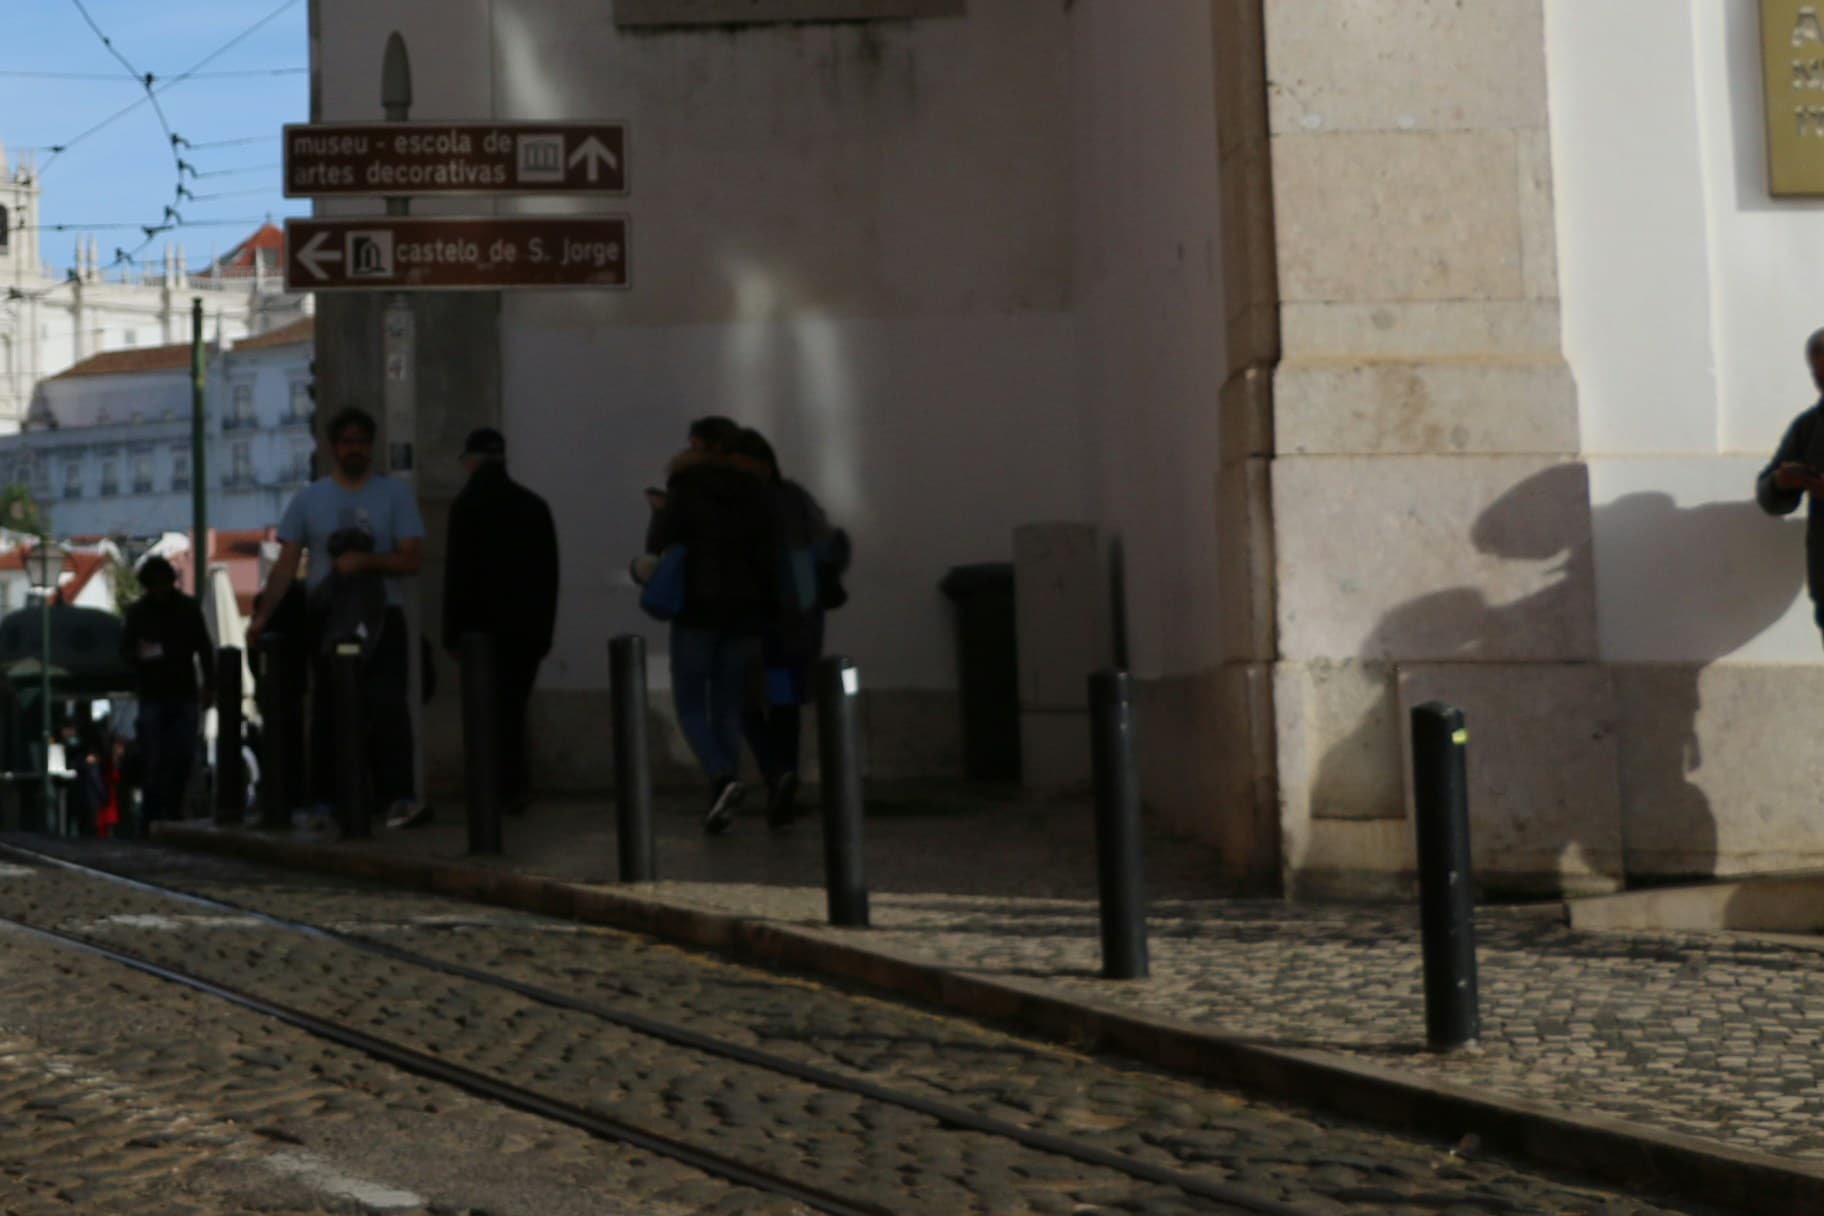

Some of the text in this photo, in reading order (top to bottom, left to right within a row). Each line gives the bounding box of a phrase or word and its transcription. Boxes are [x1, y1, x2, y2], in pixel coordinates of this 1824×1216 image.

[293, 134, 369, 156] museu
[393, 129, 472, 155] escola
[482, 129, 513, 155] de
[293, 159, 507, 185] artes decorativas
[395, 237, 479, 263] castelo
[488, 237, 518, 262] de
[527, 237, 552, 263] S.
